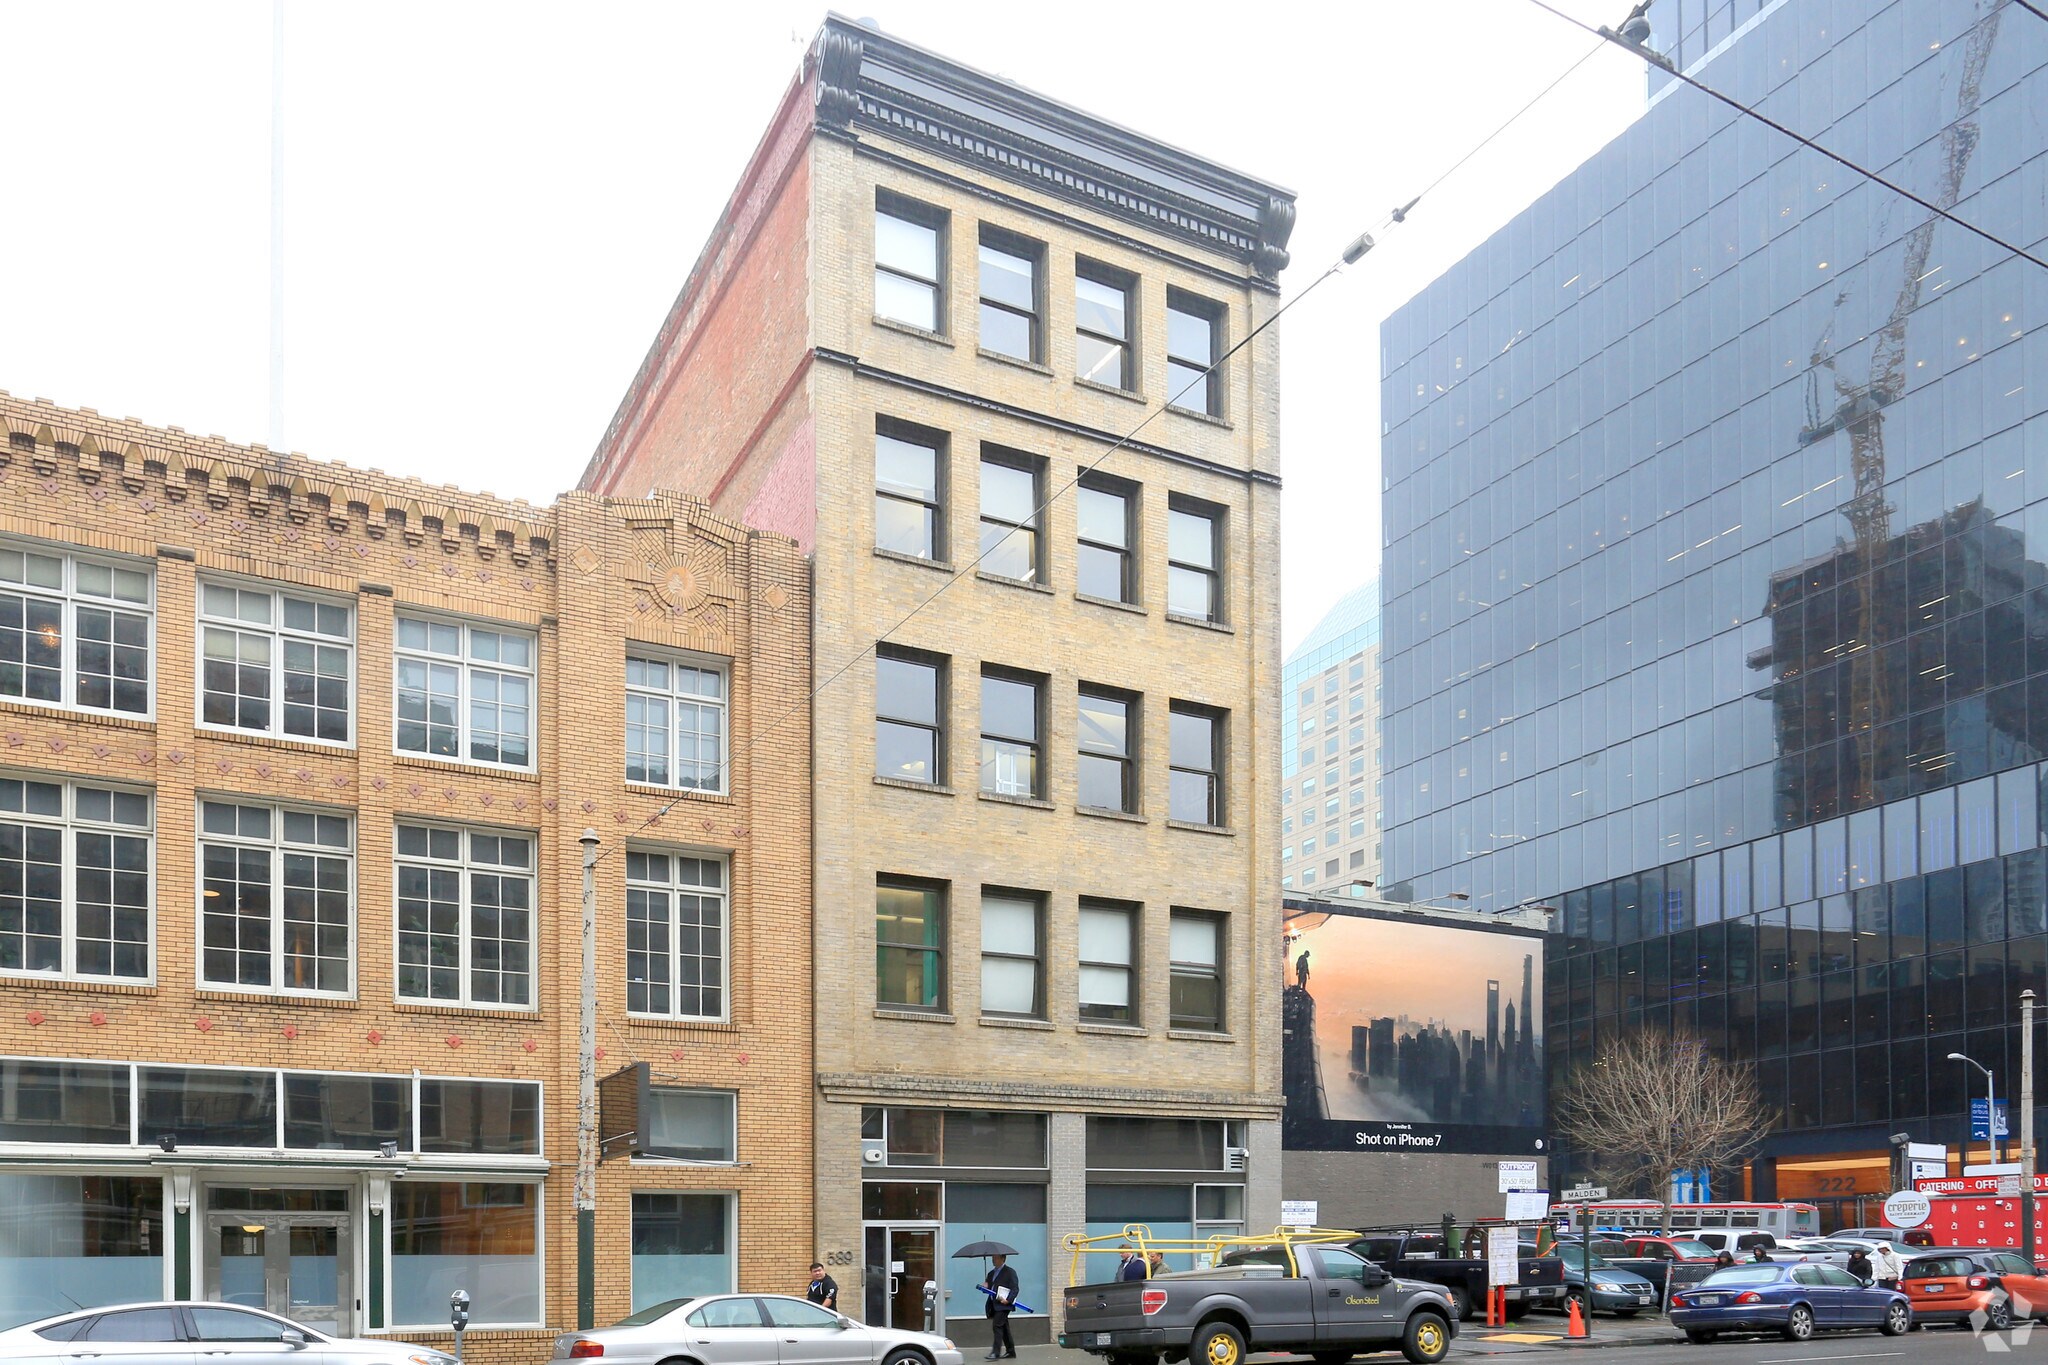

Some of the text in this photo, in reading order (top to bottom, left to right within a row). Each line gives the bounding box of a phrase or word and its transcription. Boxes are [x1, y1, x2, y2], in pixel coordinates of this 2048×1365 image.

[1355, 1132, 1442, 1146] Shot on iPhone 7
[1819, 1175, 1856, 1192] 222
[1919, 1181, 1964, 1192] CATERING
[1975, 1179, 1997, 1189] OFFI
[1568, 1190, 1600, 1198] MALDEN
[828, 1251, 853, 1265] 589
[1345, 1294, 1379, 1305] Olson Steel
